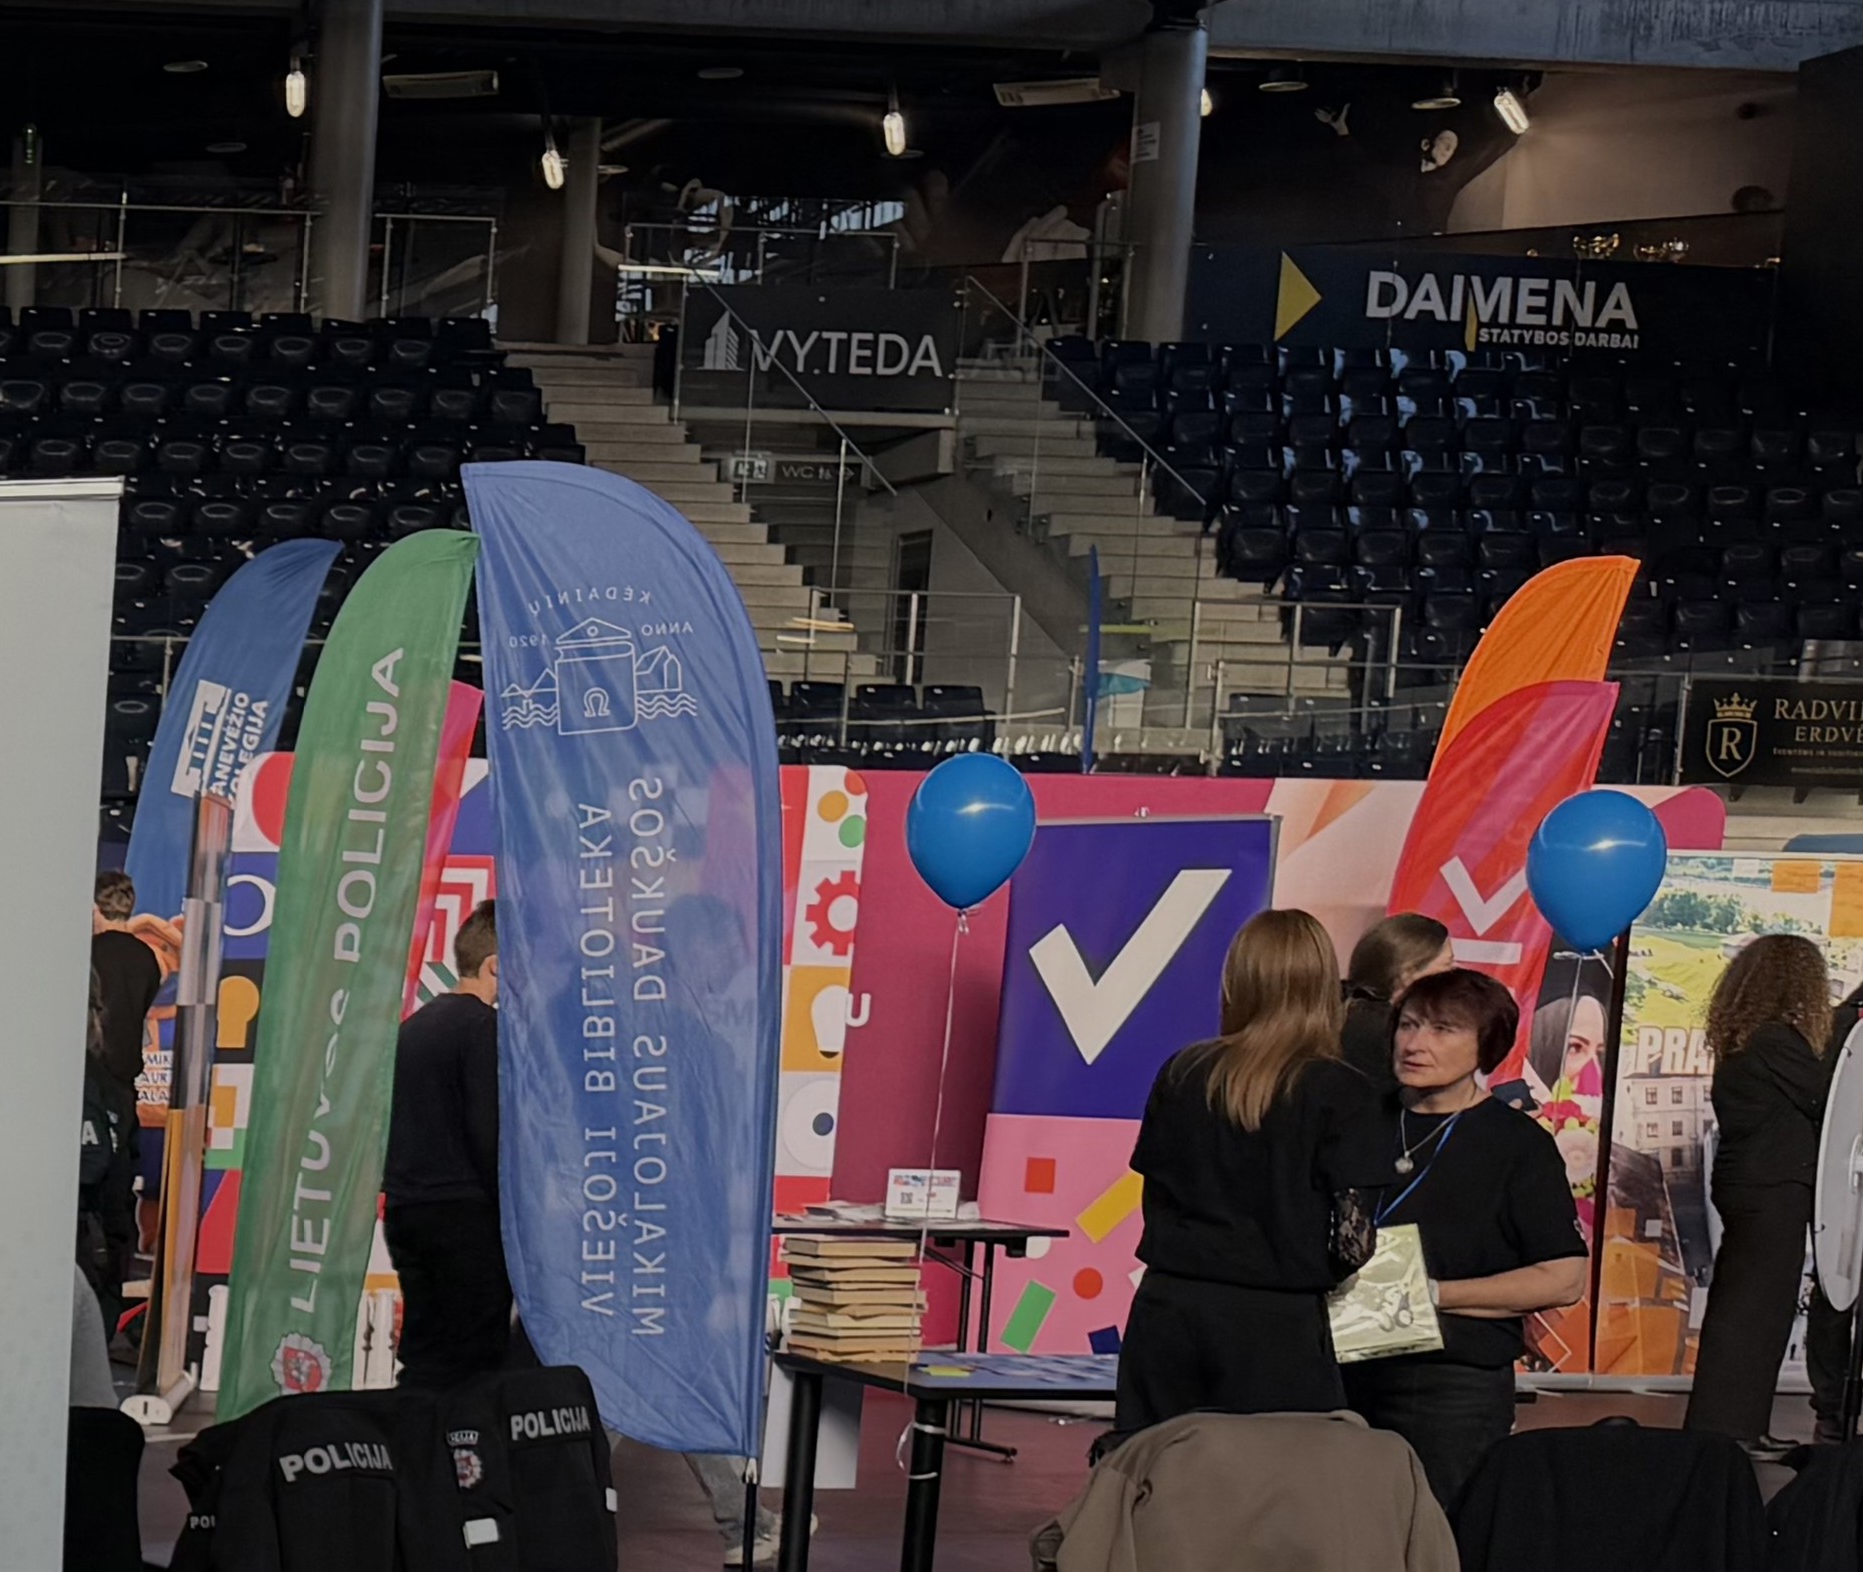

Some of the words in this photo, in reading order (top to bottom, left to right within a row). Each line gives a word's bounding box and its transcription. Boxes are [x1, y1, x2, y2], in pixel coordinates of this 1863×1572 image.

[1365, 270, 1639, 330] DAIMENA
[750, 328, 943, 378] VYTEDA
[1479, 327, 1569, 347] STATYBOS
[1573, 329, 1639, 349] DARBAI
[781, 465, 814, 478] WC
[1774, 697, 1863, 721] RADVI
[208, 690, 250, 798] ANEVĖŽIO
[332, 646, 405, 964] POLICIJA
[510, 1405, 591, 1442] POLICIJA
[278, 1442, 394, 1484] POLICIJA
